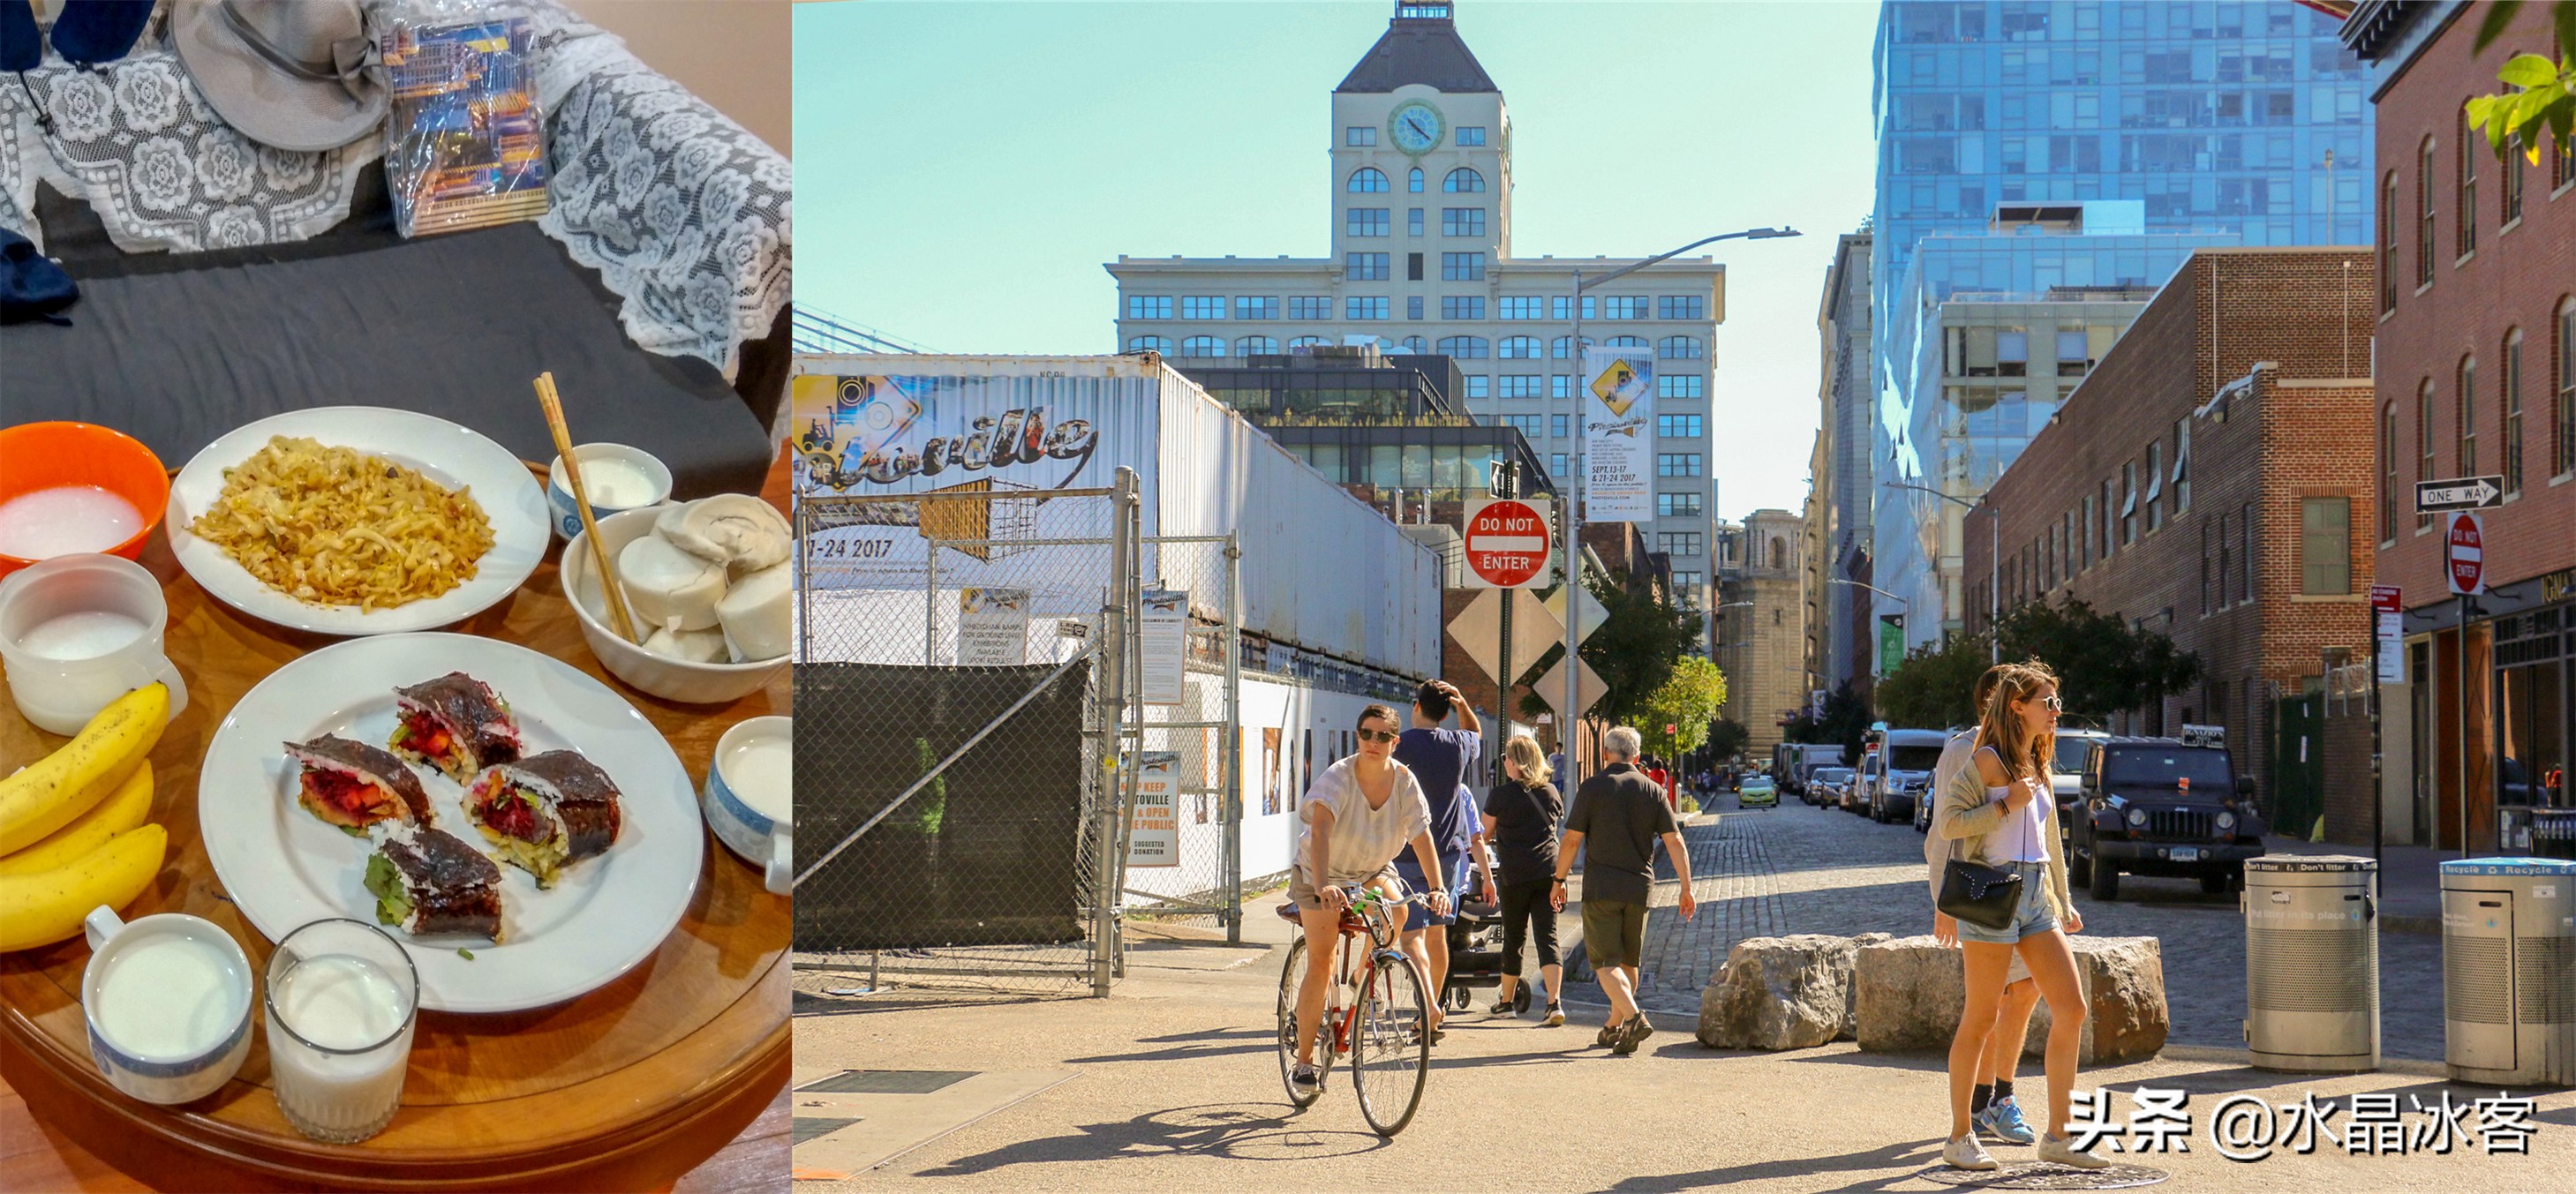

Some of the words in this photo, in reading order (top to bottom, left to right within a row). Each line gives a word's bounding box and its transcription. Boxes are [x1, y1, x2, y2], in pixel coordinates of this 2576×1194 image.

[2428, 490, 2452, 503] ONE
[2464, 487, 2489, 499] WAY
[1480, 518, 1500, 531] DO
[1506, 518, 1534, 531] NOT
[2454, 529, 2463, 541] DO
[2465, 530, 2477, 543] NOT
[852, 539, 893, 558] 2017
[1483, 556, 1529, 570] ENTER
[2457, 565, 2476, 578] ENTER
[1141, 755, 1180, 767] hotoville
[1144, 782, 1165, 792] KEEP
[1146, 807, 1170, 817] OPEN
[1141, 820, 1174, 830] PUBLIC
[2505, 866, 2552, 875] Recycle
[2288, 910, 2296, 919] in
[2301, 911, 2315, 920] its
[2317, 910, 2346, 920] place
